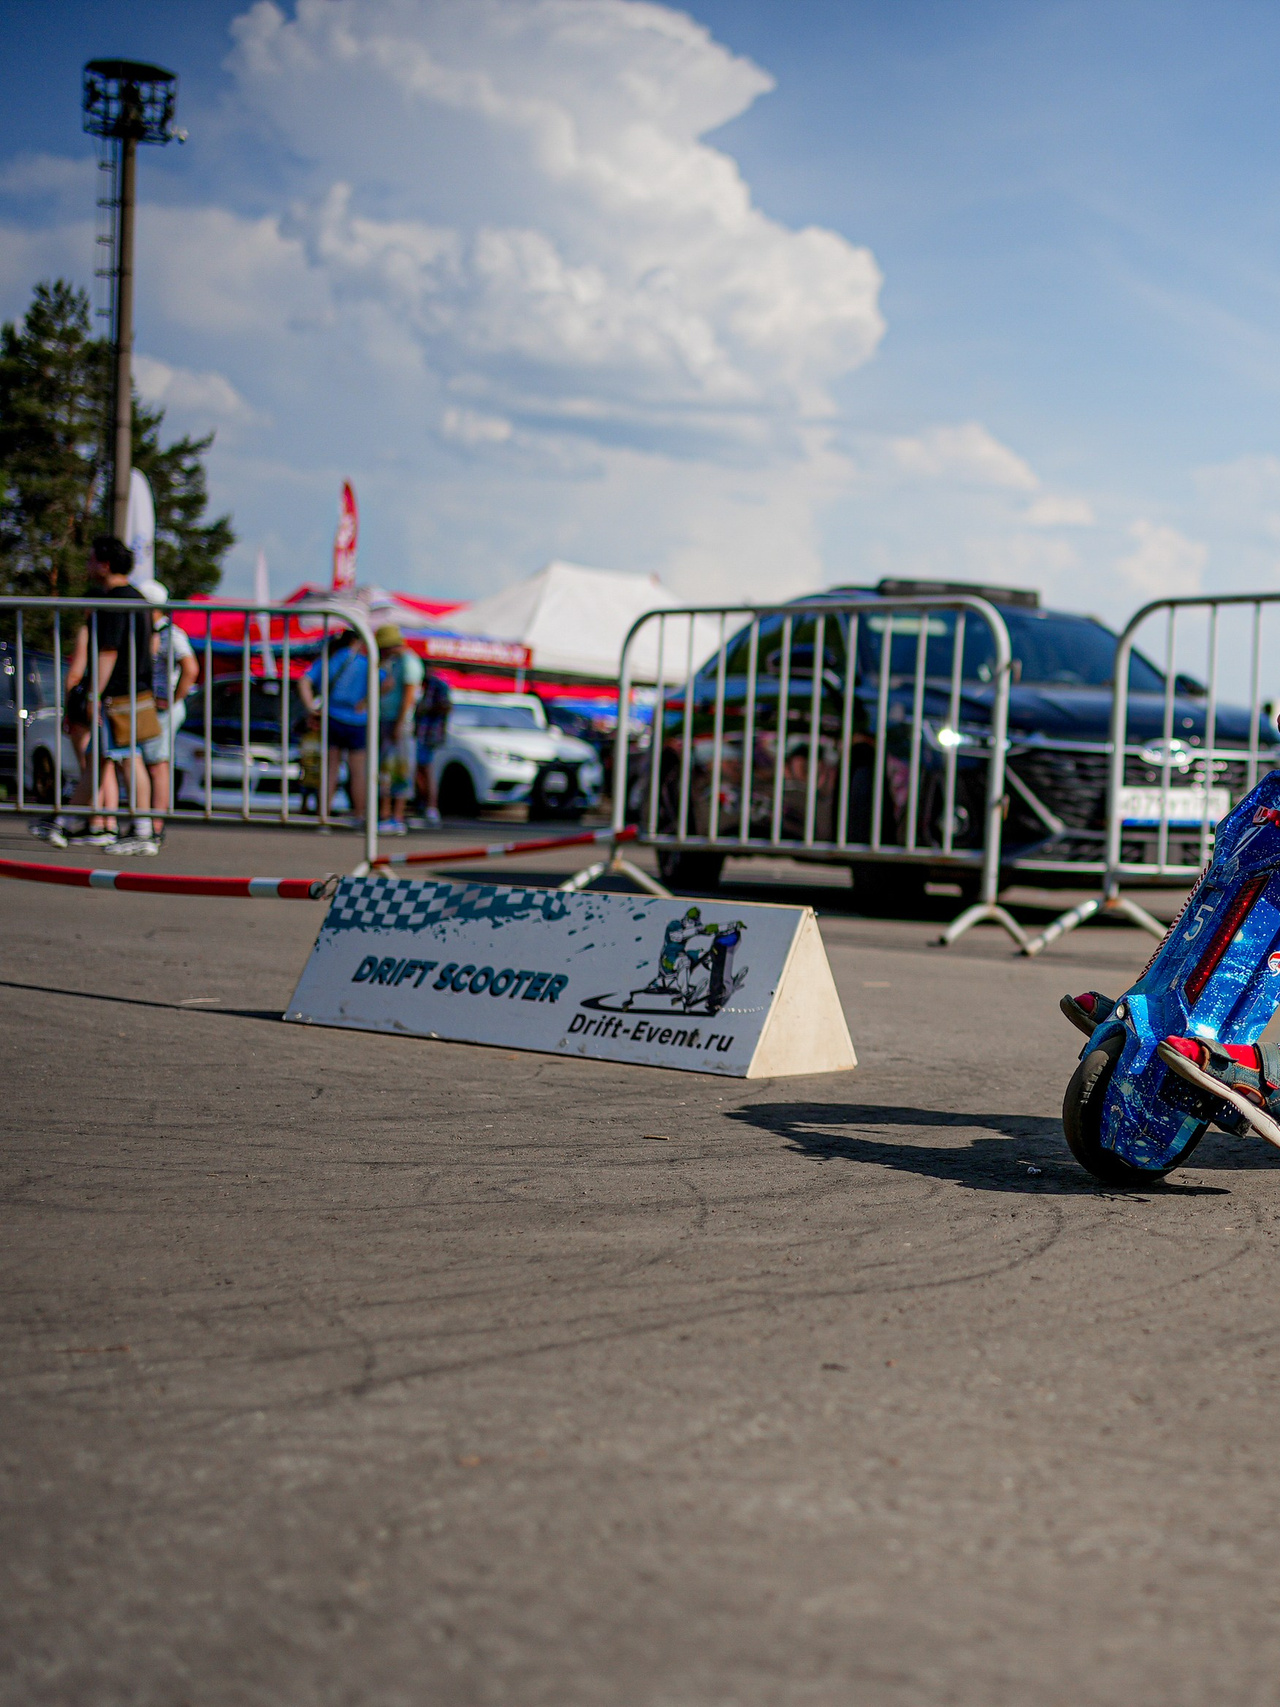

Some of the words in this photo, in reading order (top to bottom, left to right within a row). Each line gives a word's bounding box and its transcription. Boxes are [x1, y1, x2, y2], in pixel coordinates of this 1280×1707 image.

[1183, 904, 1214, 941] 5
[351, 955, 439, 989] DRIFT
[432, 962, 569, 1003] SCOOTER
[567, 1013, 735, 1052] Drift-Event.ru
